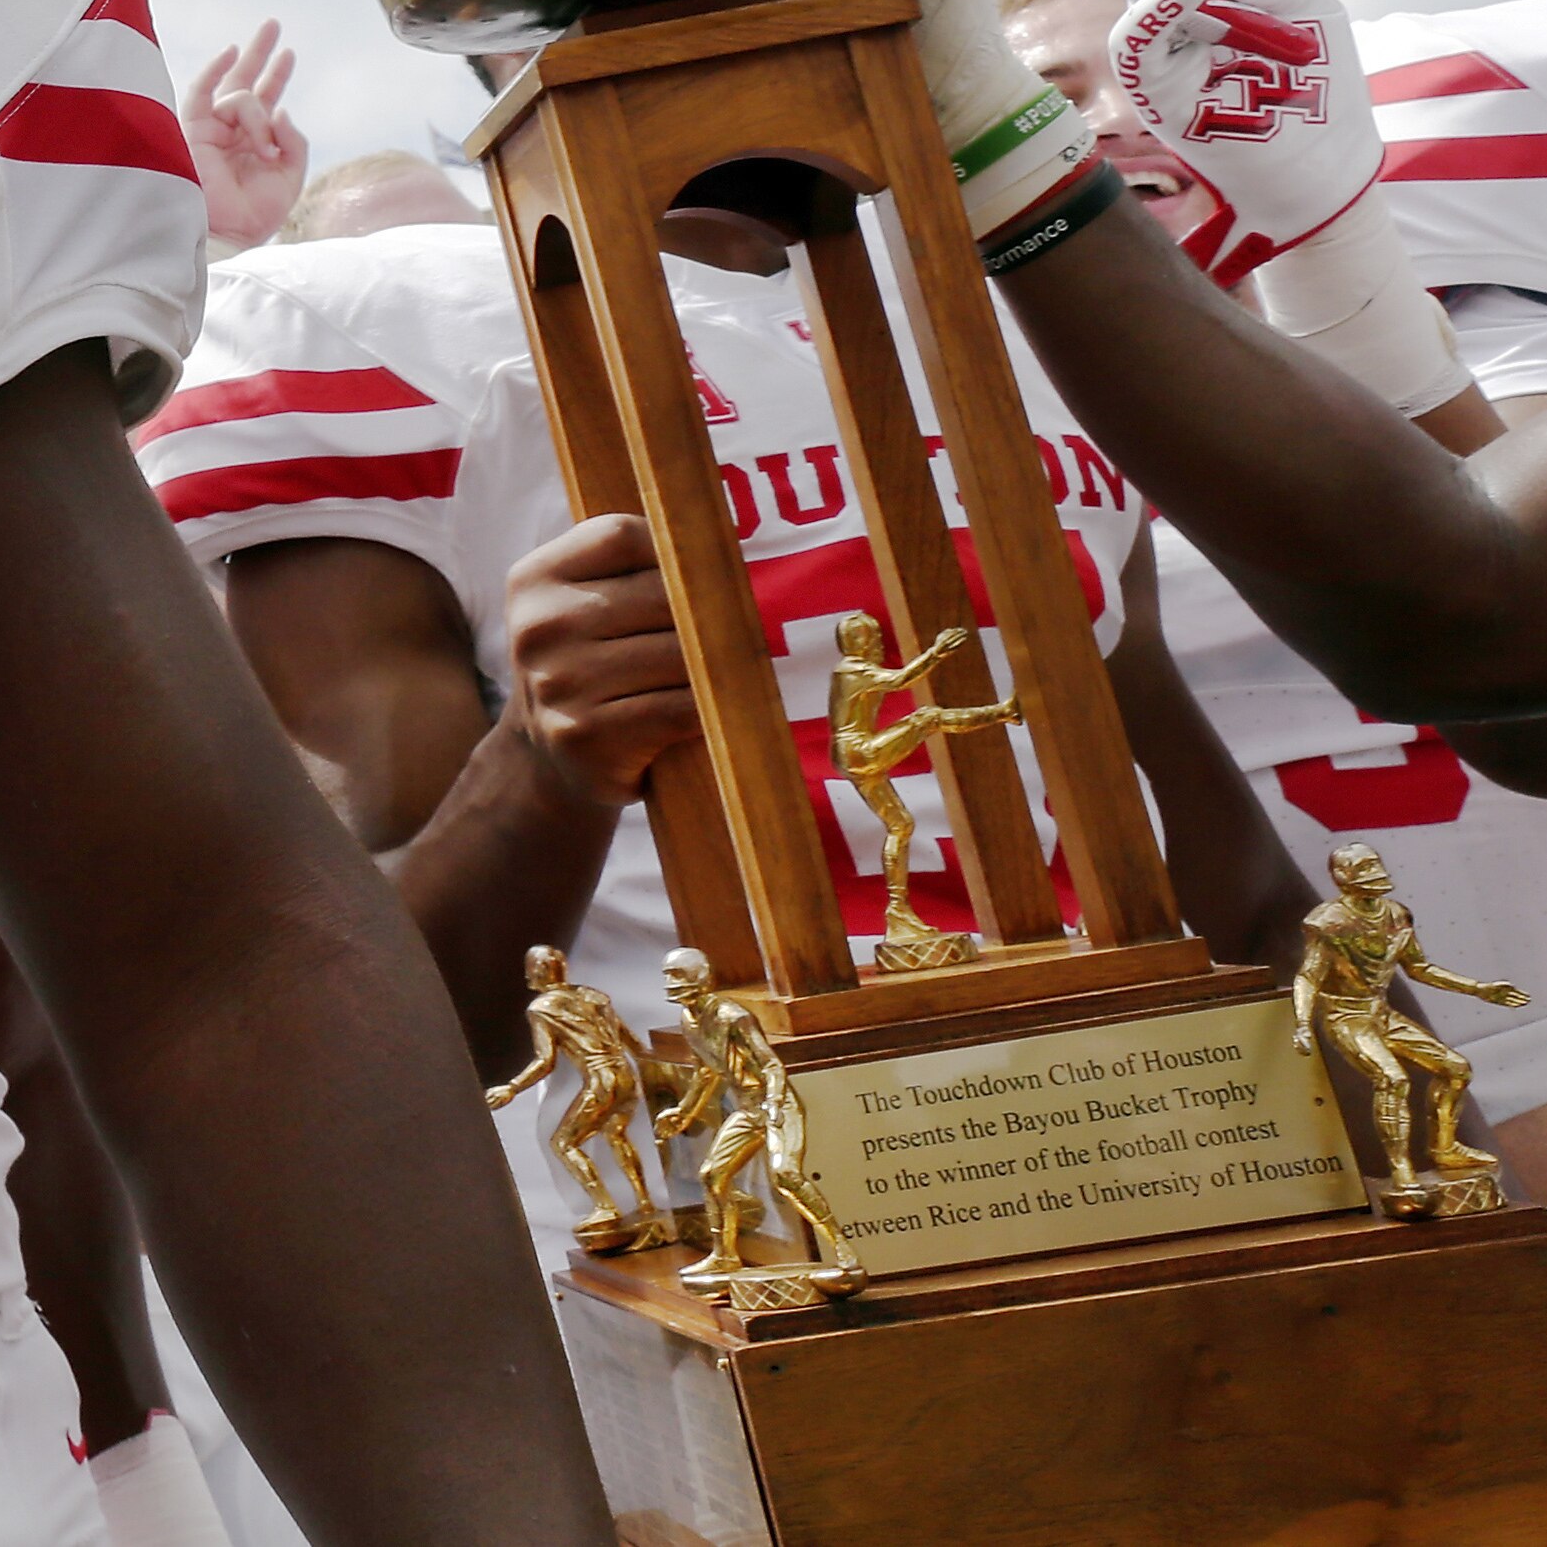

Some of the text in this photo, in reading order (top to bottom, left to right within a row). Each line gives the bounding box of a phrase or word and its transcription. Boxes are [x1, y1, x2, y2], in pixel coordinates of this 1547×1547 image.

[985, 218, 1070, 270] ormance
[855, 1044, 1242, 1113] The Touchdown Club of Houston
[861, 1080, 1257, 1160] presents the Bayou Bucket Trophy
[866, 1120, 1280, 1195] to the winner of the football contest
[841, 1155, 1344, 1239] etween Rice and the University of Houston
